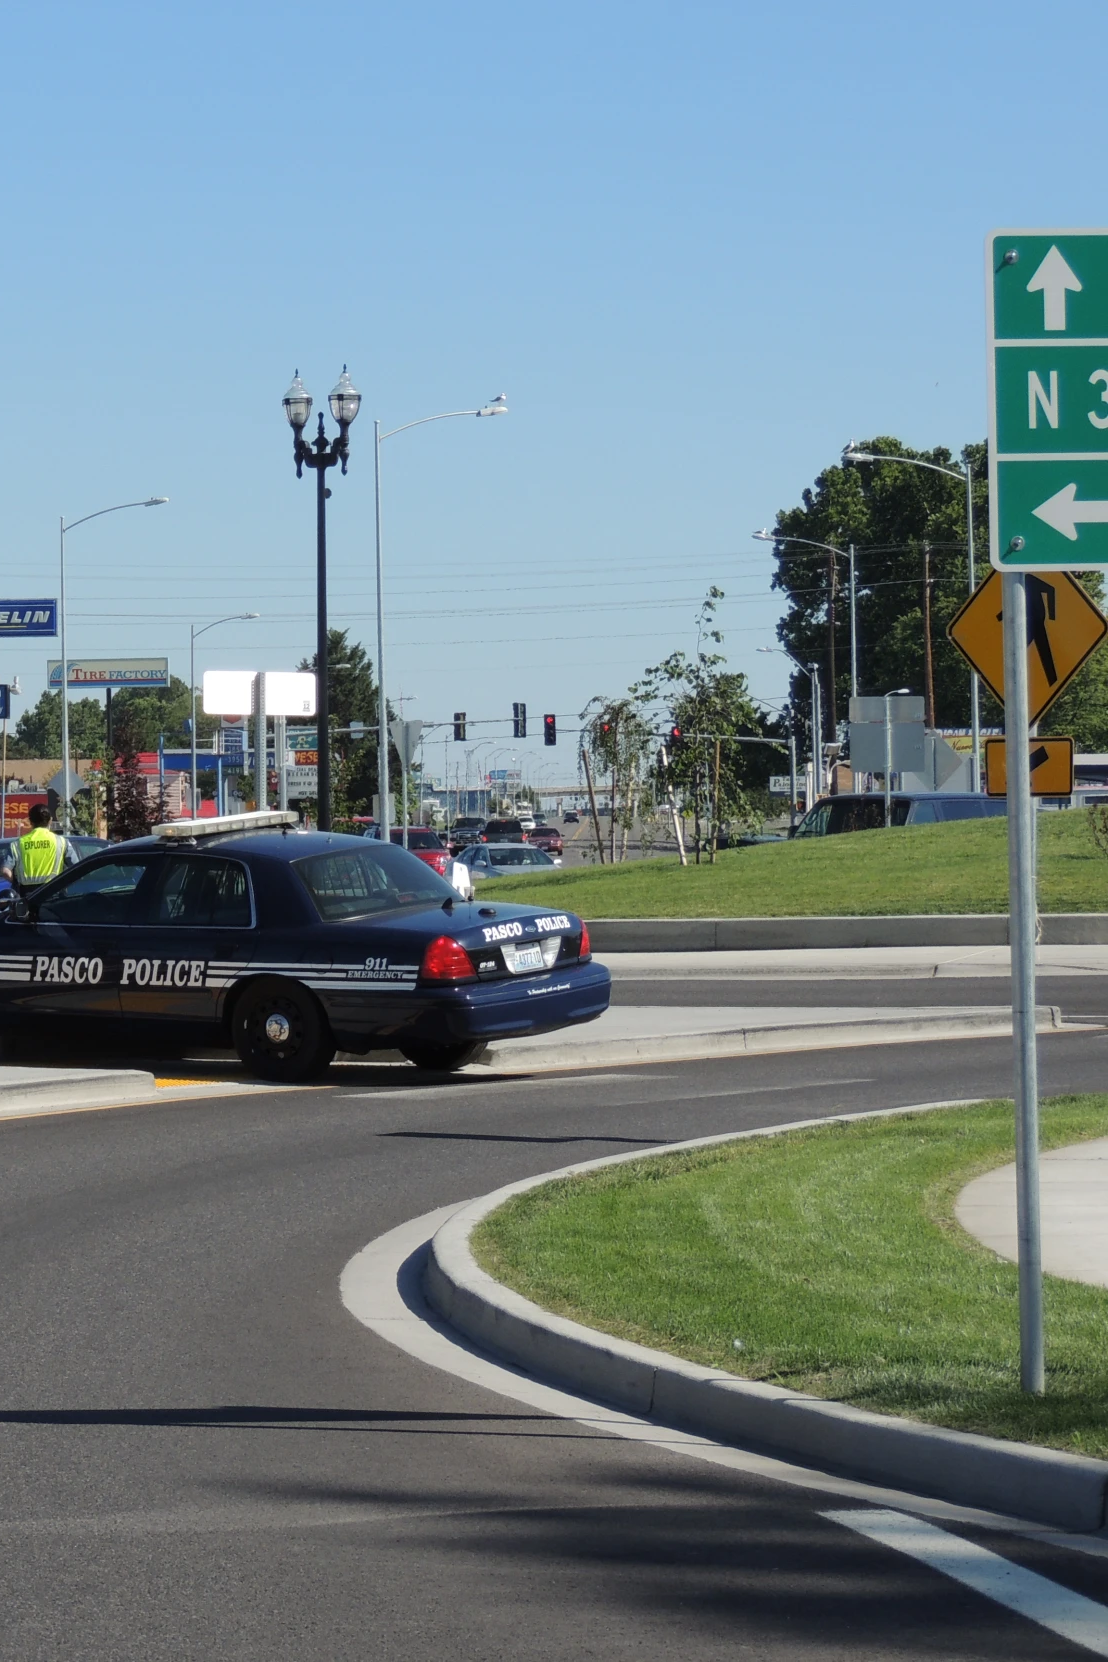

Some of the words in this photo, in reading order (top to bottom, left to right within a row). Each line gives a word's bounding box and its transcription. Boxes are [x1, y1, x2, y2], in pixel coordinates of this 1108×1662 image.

[1028, 371, 1058, 429] N
[72, 668, 106, 680] TIRE
[108, 669, 166, 679] FACTORY
[24, 840, 50, 850] EXPLORER
[482, 922, 523, 942] PASCO
[534, 915, 571, 932] POLICE
[33, 955, 104, 984] PASCO
[120, 958, 205, 987] POLICE
[364, 957, 388, 971] 911
[347, 970, 404, 979] EMERGENCY
